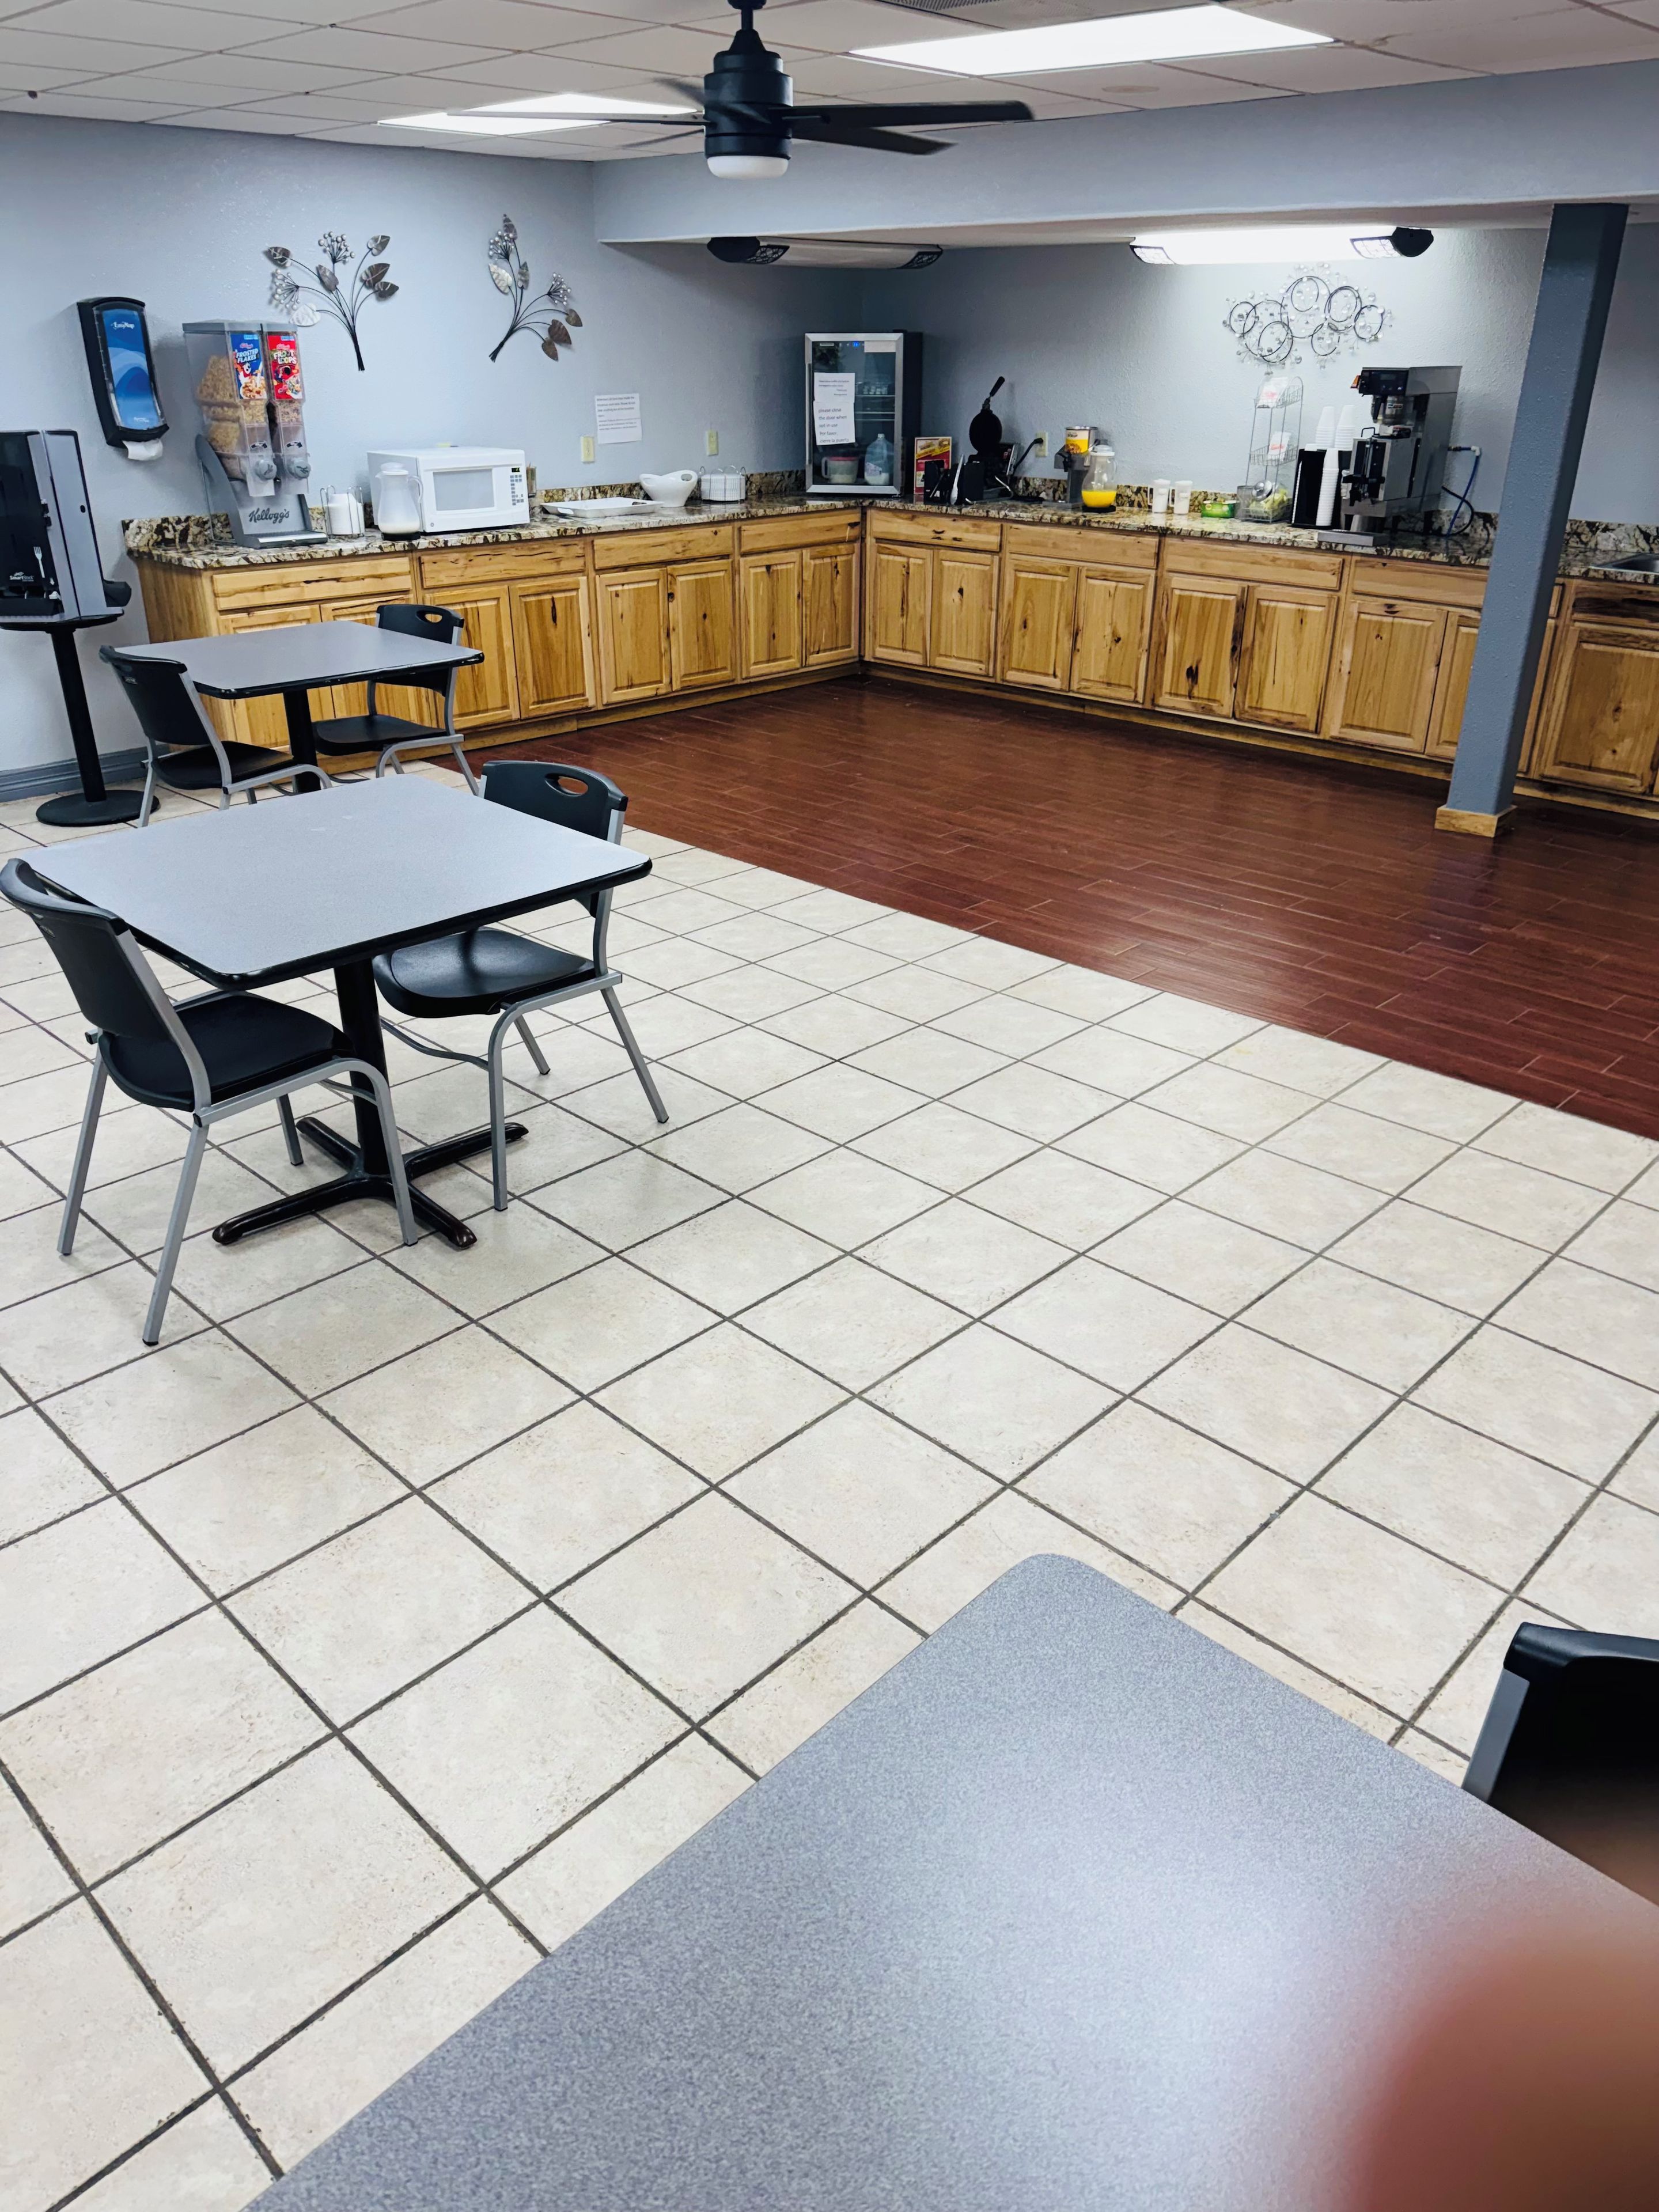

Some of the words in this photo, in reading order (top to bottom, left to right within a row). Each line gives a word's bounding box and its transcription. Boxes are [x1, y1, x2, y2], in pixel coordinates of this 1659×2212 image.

[236, 349, 259, 358] FROSTED
[237, 354, 257, 363] FLAKES
[278, 357, 297, 365] LOOPS
[248, 507, 290, 524] Kellogg's
